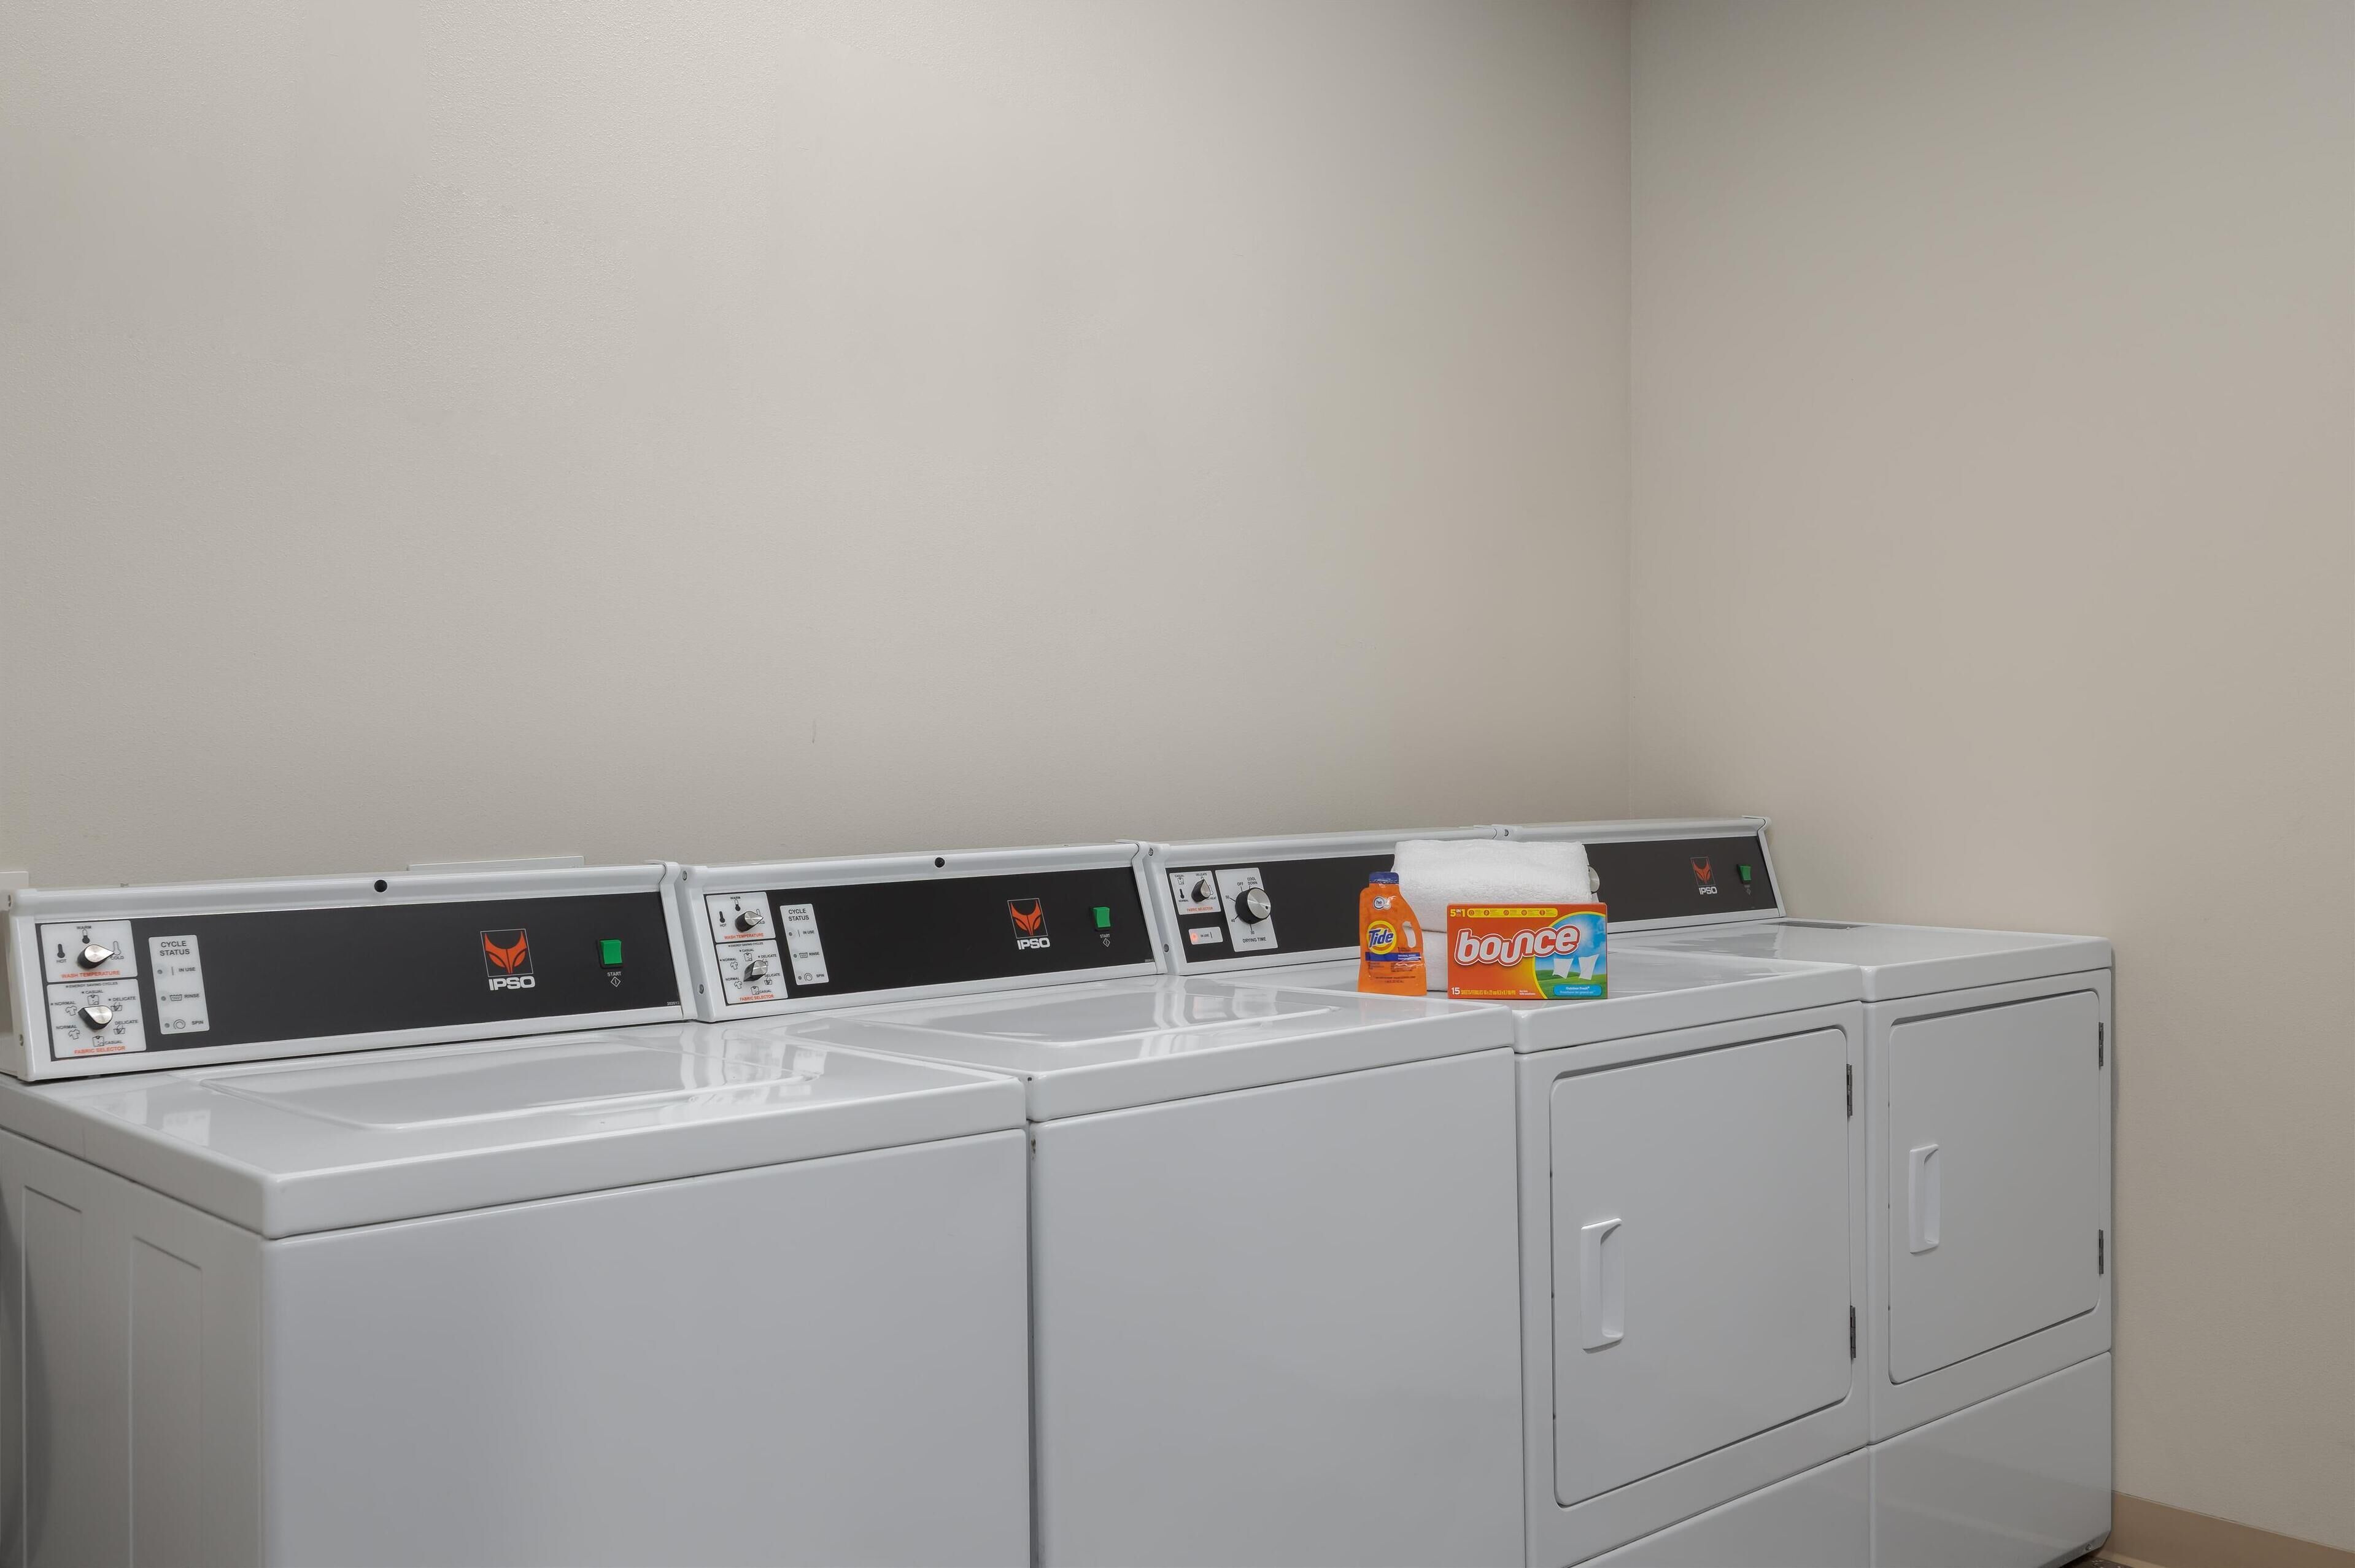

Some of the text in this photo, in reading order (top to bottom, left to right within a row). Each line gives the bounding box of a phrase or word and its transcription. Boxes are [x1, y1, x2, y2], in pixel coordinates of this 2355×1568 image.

[1699, 886, 1717, 895] IPSO
[1017, 937, 1050, 950] IPSO
[1368, 929, 1394, 948] Tide
[1455, 925, 1580, 966] bounce
[489, 976, 535, 991] IPSO
